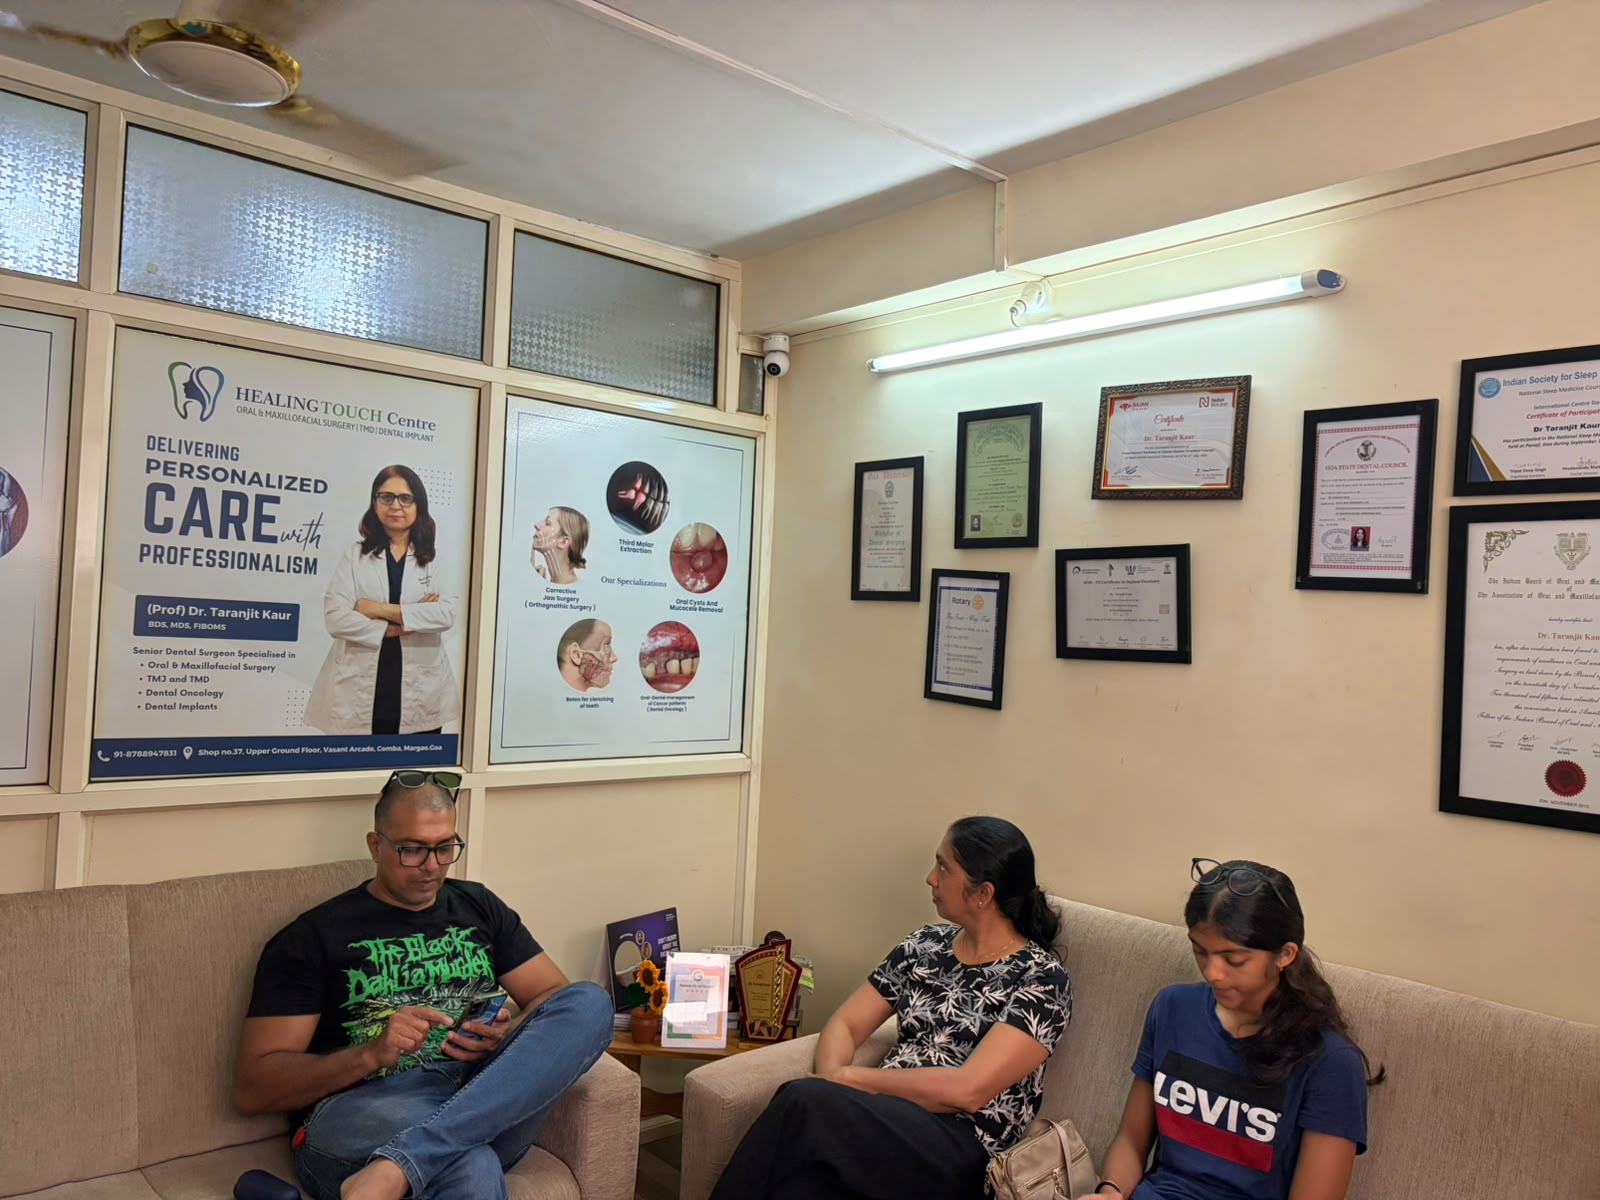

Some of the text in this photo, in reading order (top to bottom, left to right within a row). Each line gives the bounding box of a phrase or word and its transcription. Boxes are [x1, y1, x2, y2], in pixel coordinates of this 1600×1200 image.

[1503, 378, 1527, 386] Indian
[1529, 375, 1558, 384] Society
[1561, 373, 1572, 381] for
[1534, 402, 1570, 410] International
[236, 405, 434, 442] ORAL & MAXILLOFACIAL SURGERY TMD DENTAL IMPLANT
[387, 412, 436, 431] Centre
[147, 435, 240, 461] DELIVERING
[145, 458, 328, 494] PERSONALIZED
[144, 482, 325, 551] CARE with
[139, 543, 318, 575] PROFESSIONALISM
[601, 576, 667, 587] Our Specializations
[528, 602, 592, 612] Orthognathic Surgery
[952, 597, 970, 606] Rotary
[147, 604, 291, 620] (Prof) Dr. Taranjit Kaur
[133, 647, 163, 655] Senior
[166, 647, 196, 656] Dental
[199, 649, 235, 658] Surgeon
[238, 650, 286, 659] Specialised
[148, 661, 169, 669] Oral
[181, 661, 240, 671] Maxillofacial
[243, 663, 275, 673] Surgery
[147, 675, 166, 683] TMJ
[180, 689, 223, 699] Oncology
[179, 703, 217, 712] Implants
[114, 750, 177, 758] 91-8788947831
[246, 748, 270, 756] Upper
[350, 745, 376, 753] Arcade,
[347, 926, 478, 968] The Black
[338, 948, 496, 1008] Dahlia Murder
